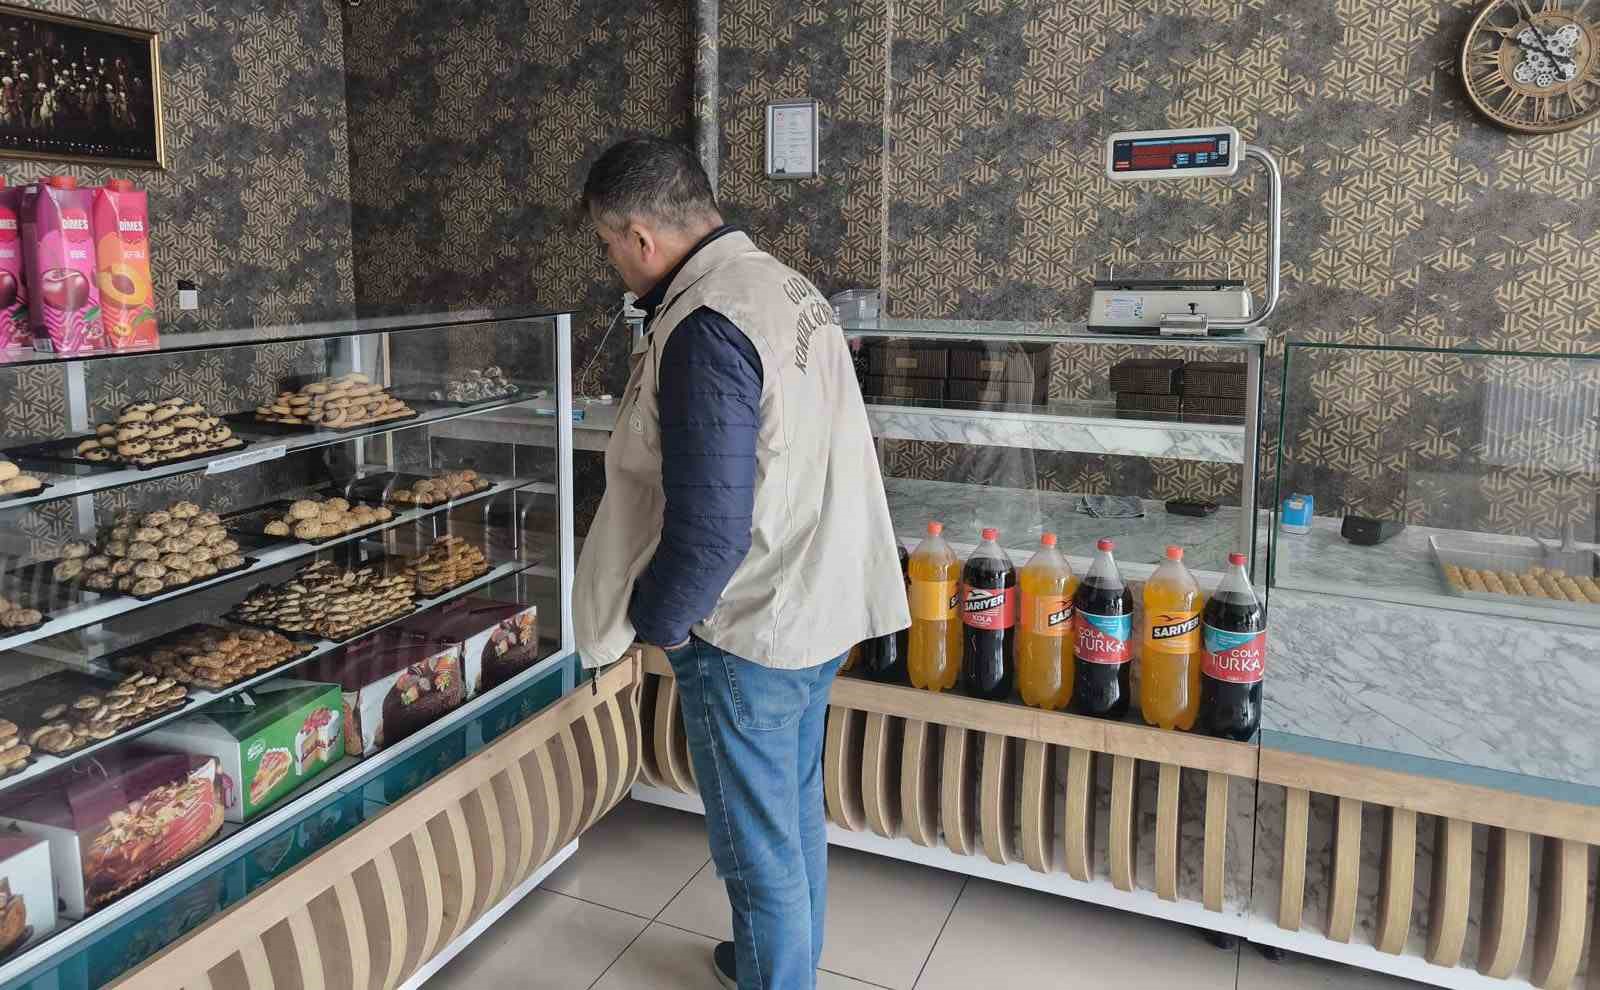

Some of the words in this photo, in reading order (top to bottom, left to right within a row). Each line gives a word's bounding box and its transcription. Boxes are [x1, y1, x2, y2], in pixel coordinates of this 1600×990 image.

[964, 594, 1004, 611] SARIYER
[972, 614, 993, 624] KOLA
[1080, 629, 1104, 639] COLA
[1079, 637, 1125, 653] TURKA
[1231, 648, 1260, 658] COLA
[1210, 655, 1261, 672] TURKA
